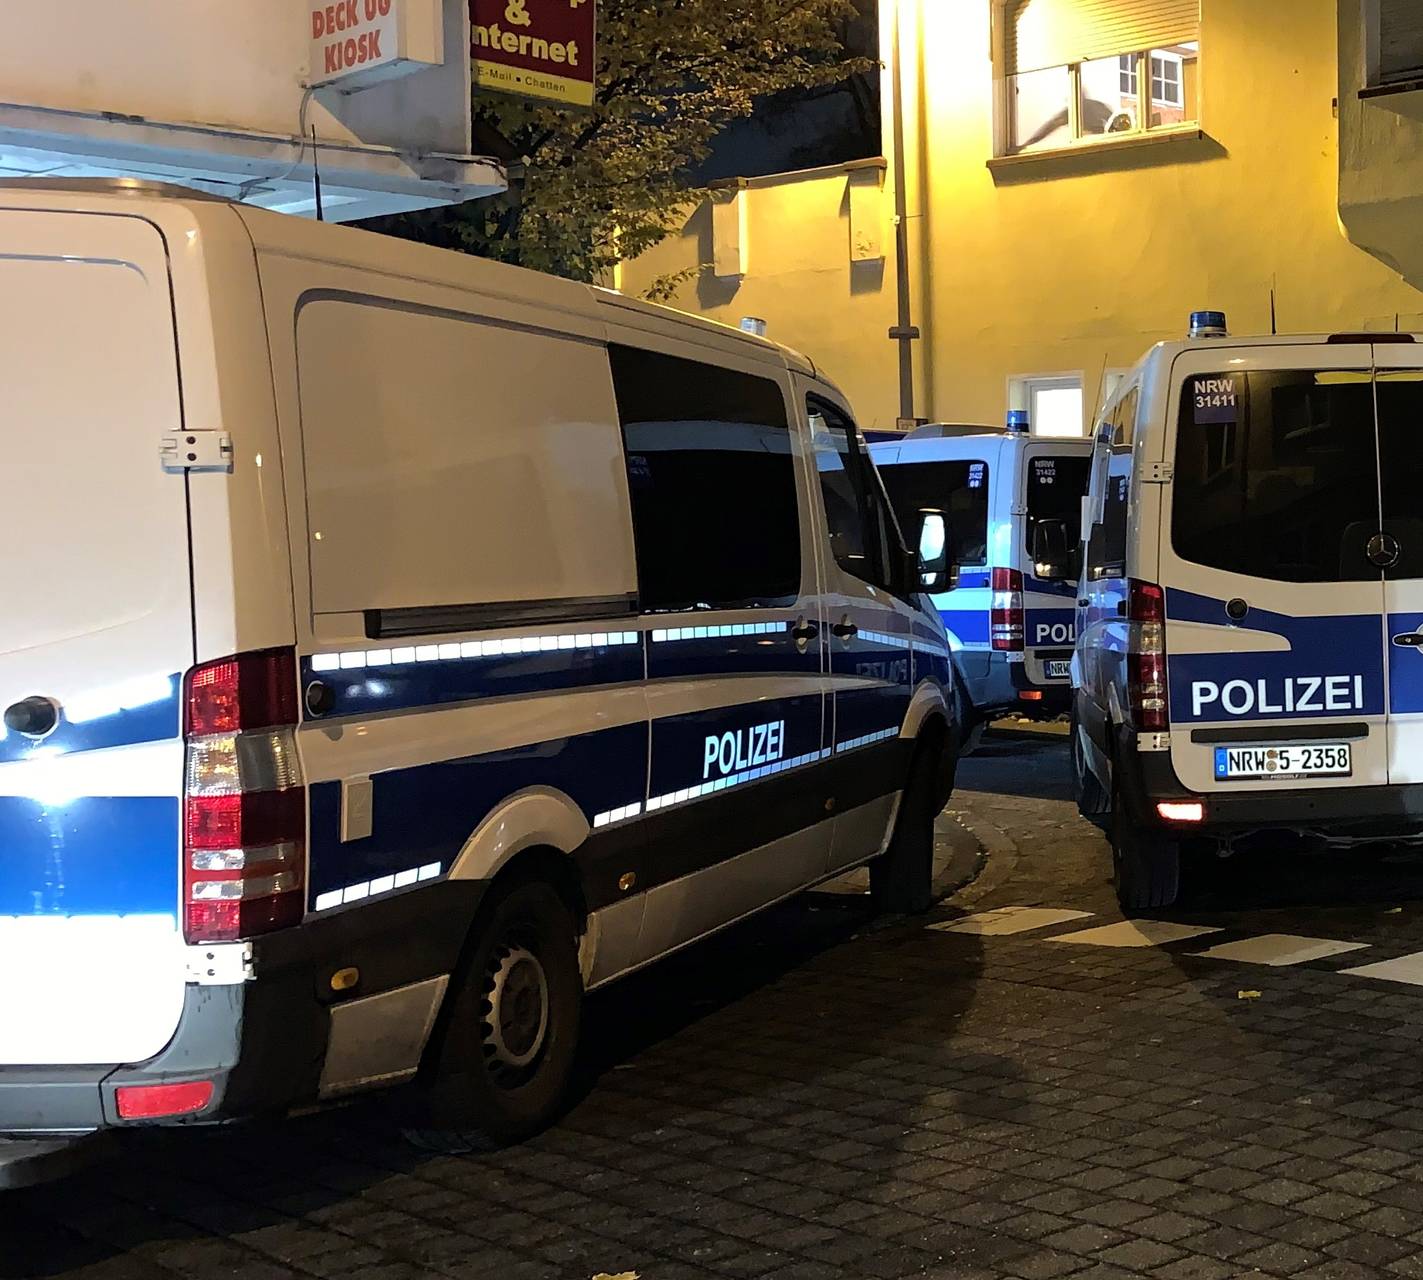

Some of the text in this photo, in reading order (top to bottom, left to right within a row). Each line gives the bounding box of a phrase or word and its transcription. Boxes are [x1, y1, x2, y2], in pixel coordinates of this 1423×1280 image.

[312, 0, 359, 39] DECK
[505, 0, 531, 27] &
[325, 29, 381, 74] KIOSK
[472, 23, 578, 66] nternet
[478, 66, 566, 93] E-Mail Chatten
[1195, 379, 1233, 393] NRW
[1196, 394, 1235, 408] 31411
[1036, 623, 1076, 642] POL
[1192, 675, 1363, 716] POLIZEI
[703, 720, 784, 779] POLIZEI
[1229, 748, 1348, 772] NRW 5-2358
